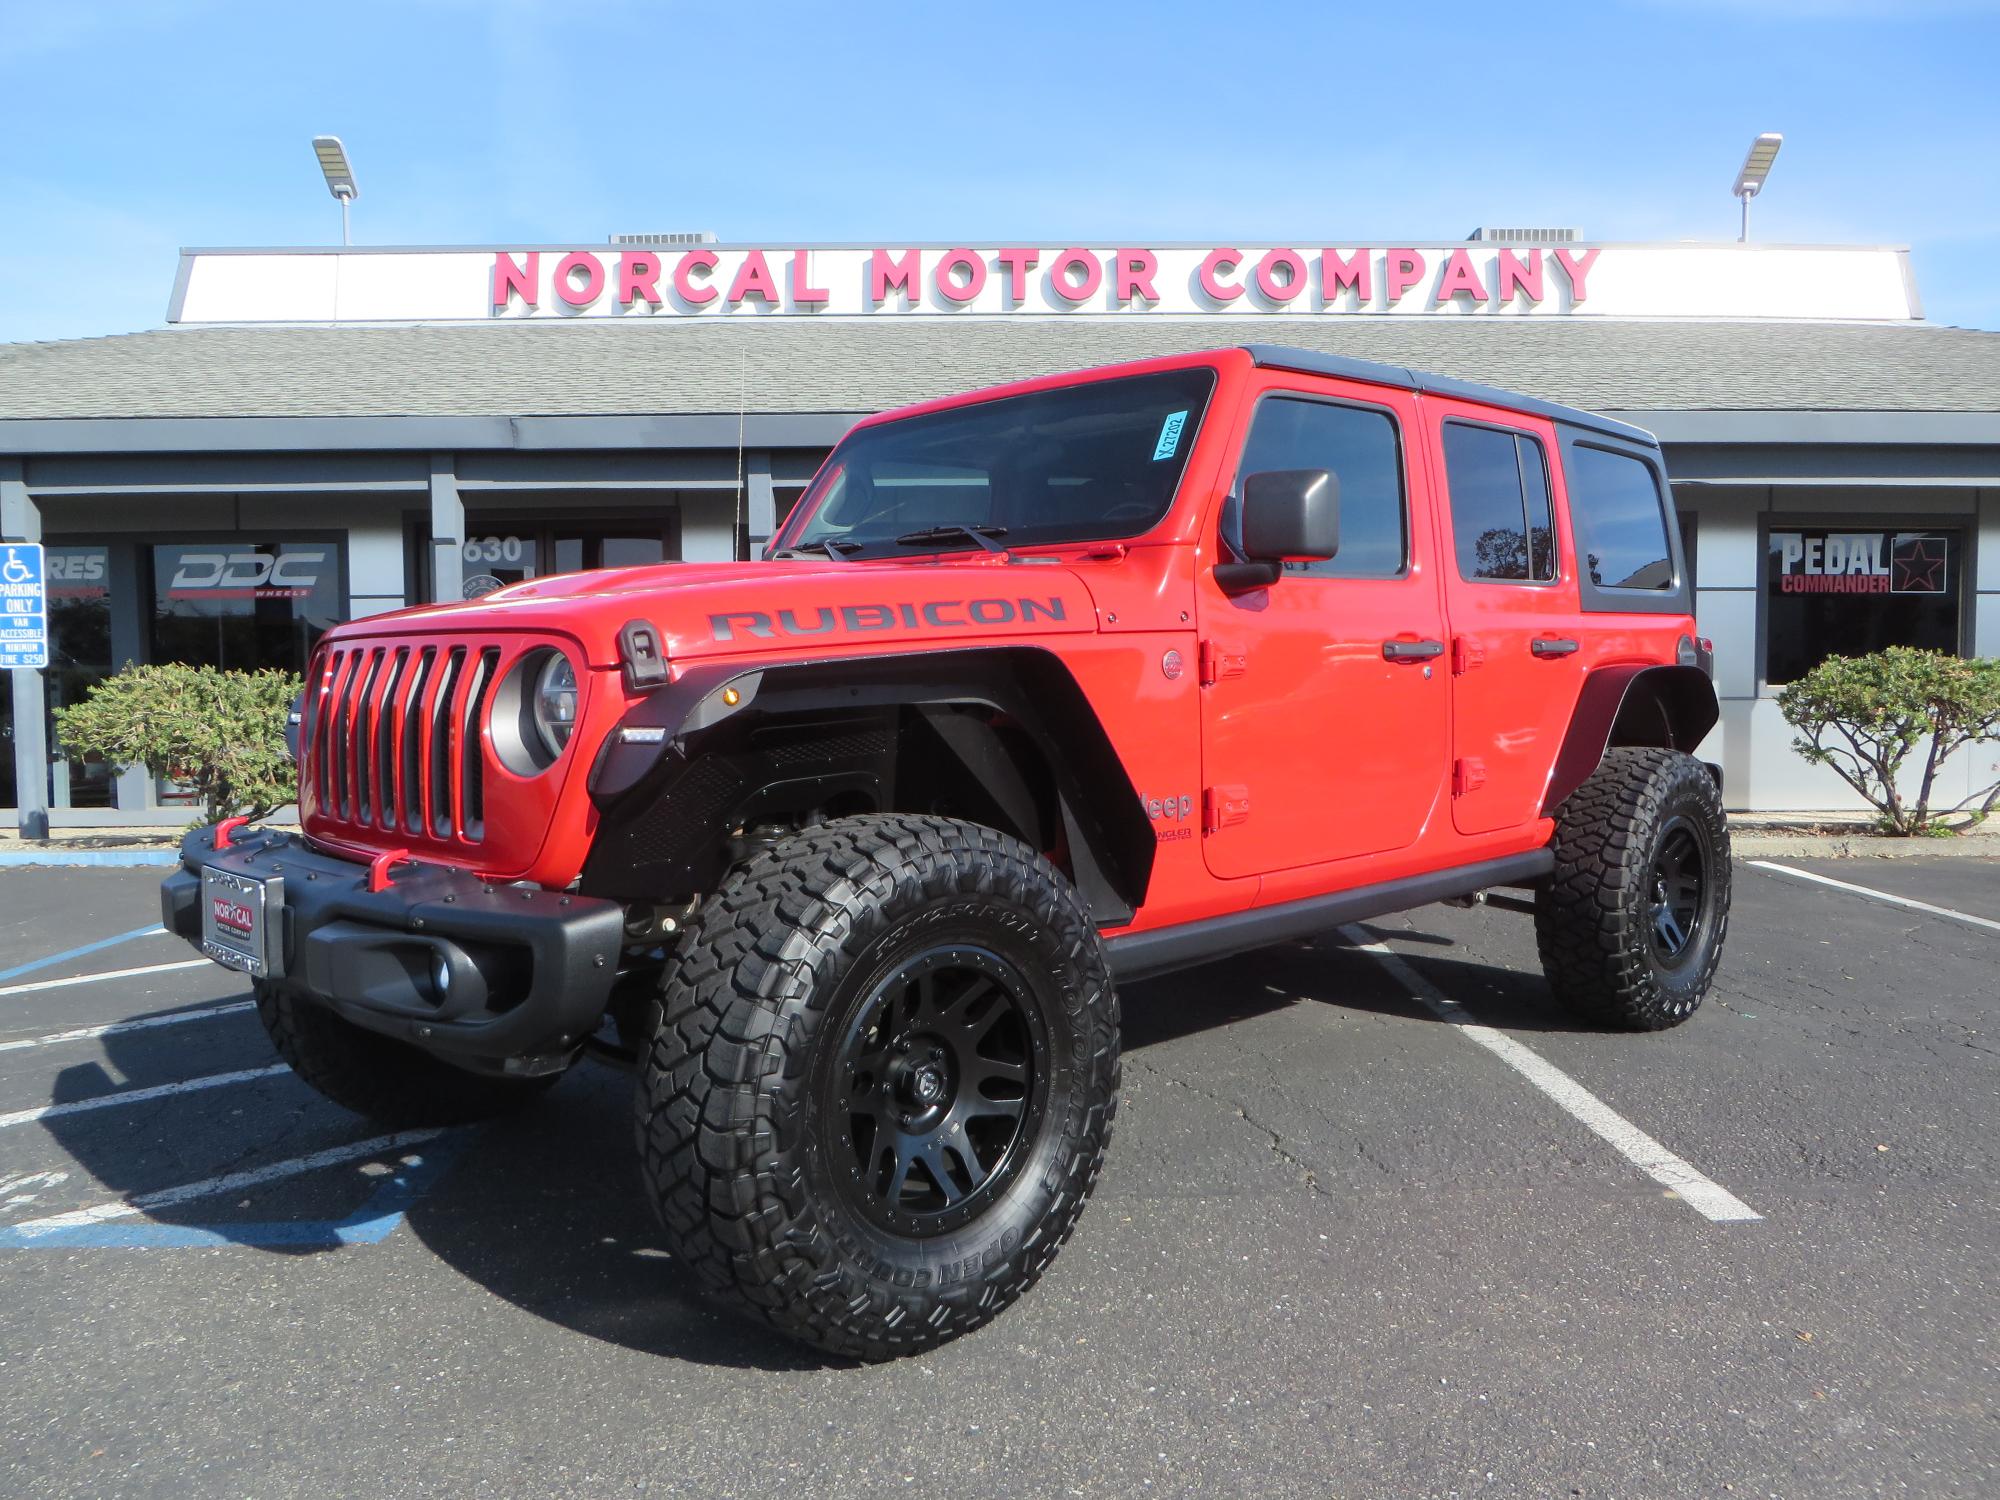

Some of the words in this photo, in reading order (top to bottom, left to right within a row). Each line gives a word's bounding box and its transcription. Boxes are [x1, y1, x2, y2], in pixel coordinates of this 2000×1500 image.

[494, 250, 829, 306] NORCAL
[872, 248, 1159, 305] MOTOR
[1200, 248, 1601, 303] COMPANY
[463, 536, 522, 562] 630
[1781, 537, 1890, 575] PEDAL
[170, 552, 325, 587] DDC
[0, 583, 40, 597] PARKING
[1781, 575, 1889, 593] COMMANDER
[6, 599, 33, 613] ONLY
[13, 618, 29, 627] VAN
[708, 597, 1067, 642] RUBICON
[0, 629, 43, 638] ACCESSIBLE
[5, 644, 38, 652] MINIMUM
[0, 654, 18, 664] FINE
[214, 901, 229, 919] NOR
[236, 908, 252, 927] CAL
